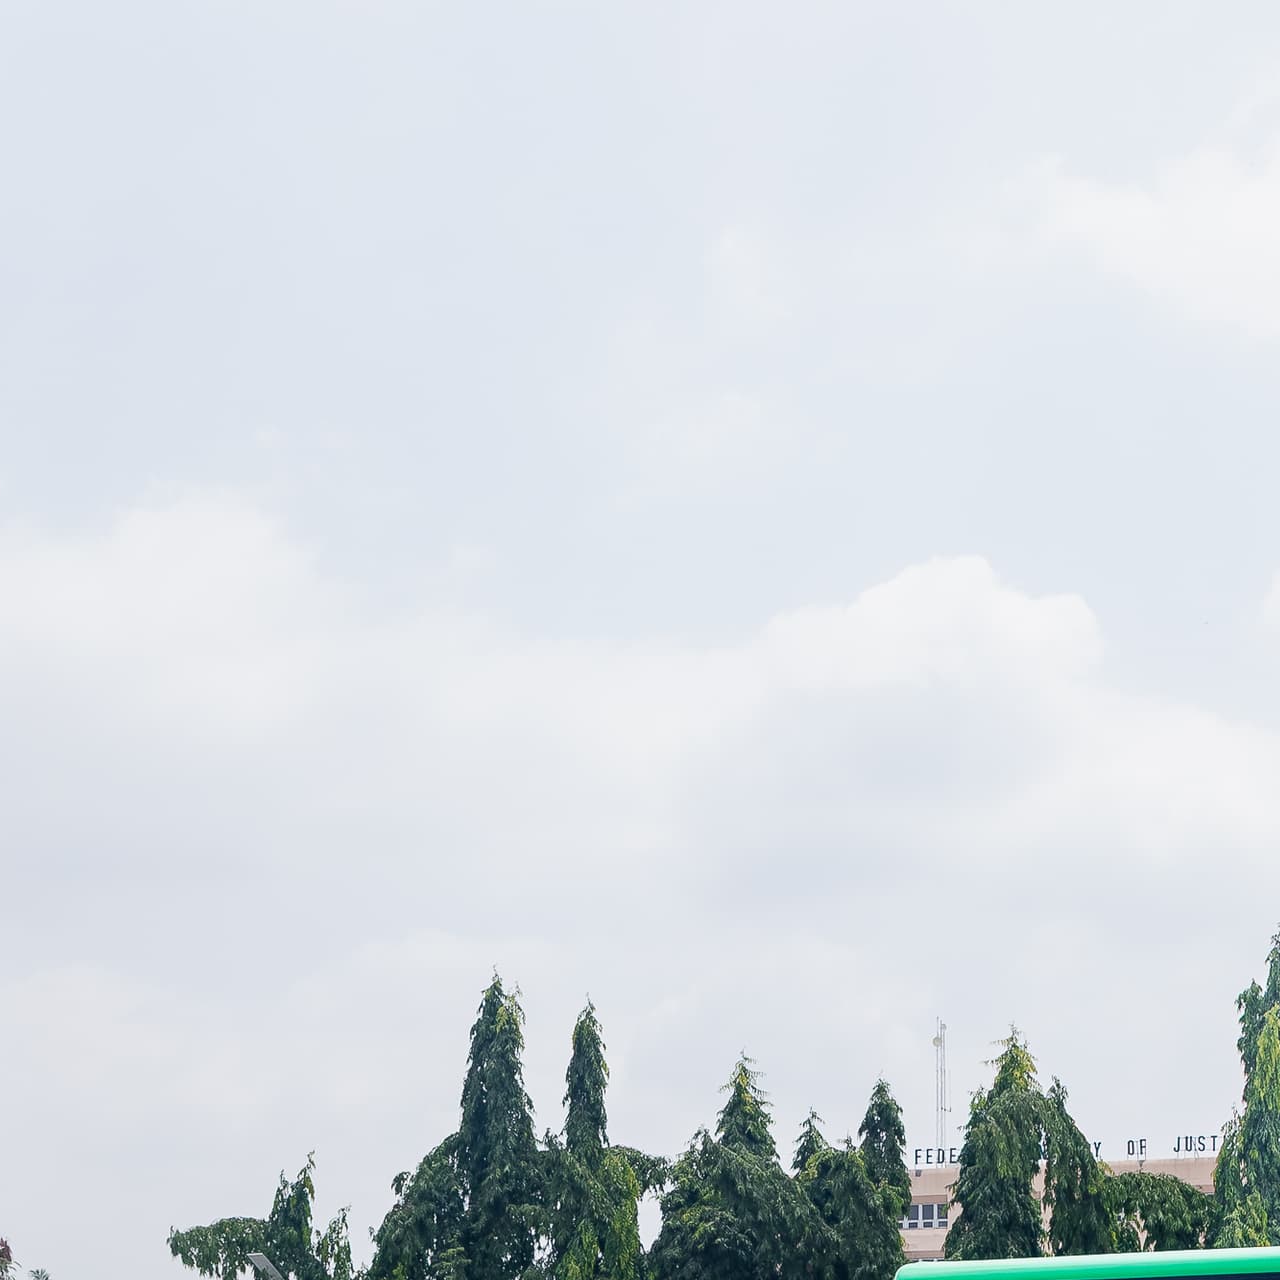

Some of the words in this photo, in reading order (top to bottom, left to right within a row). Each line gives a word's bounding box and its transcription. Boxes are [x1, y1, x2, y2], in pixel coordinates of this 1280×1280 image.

[914, 1147, 957, 1165] FEDE
[1127, 1138, 1147, 1156] OF
[1173, 1135, 1218, 1152] JUST
